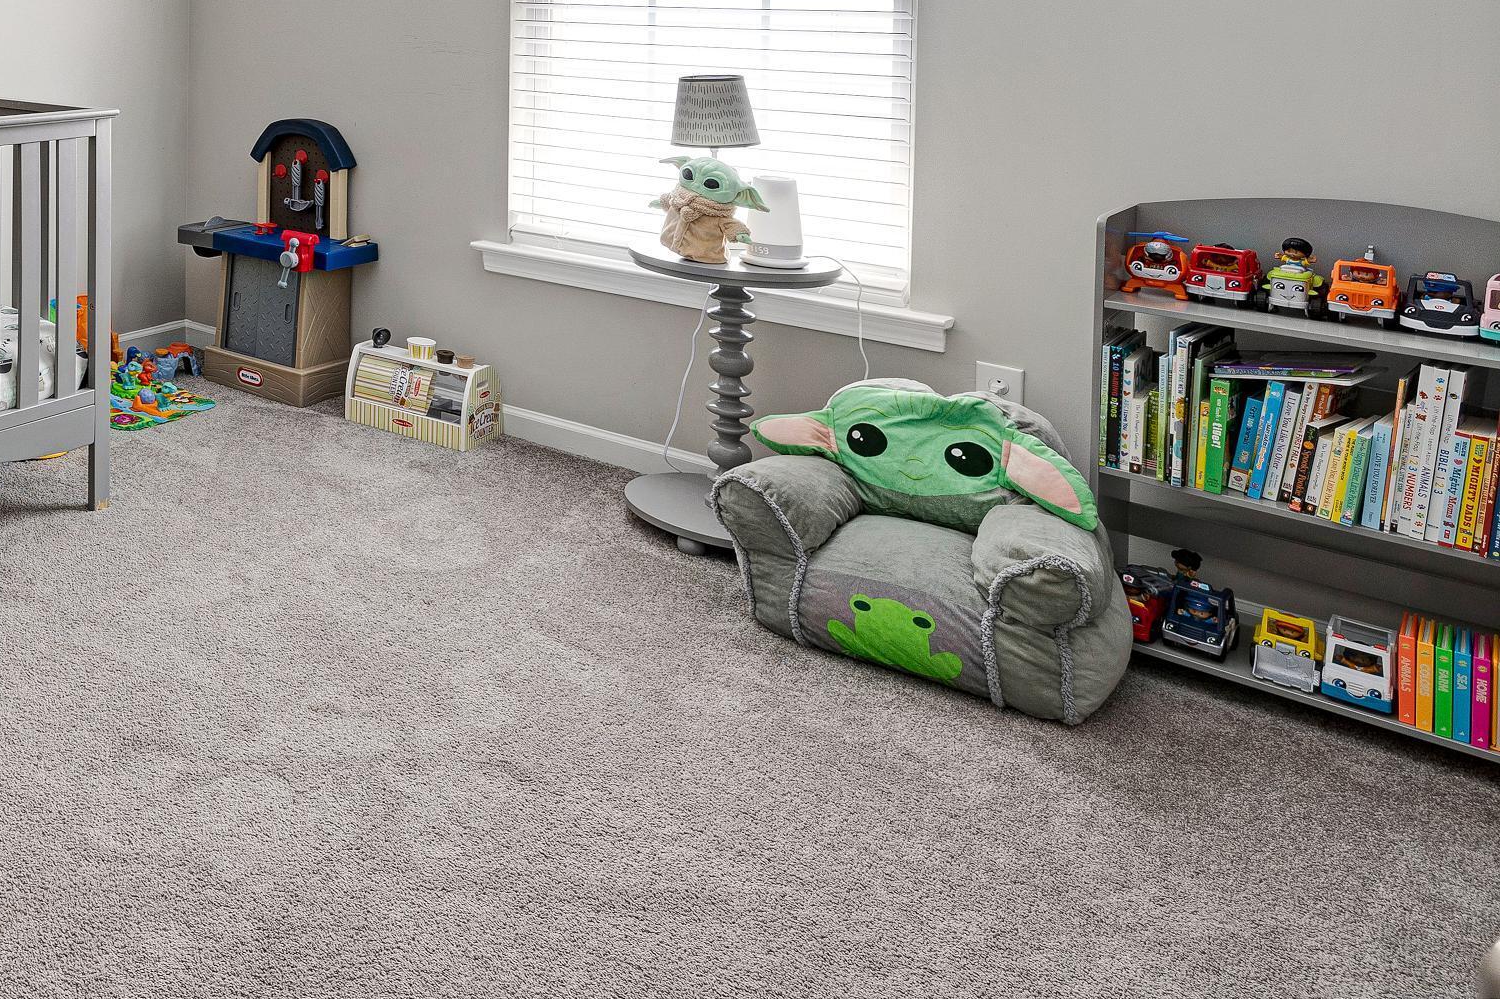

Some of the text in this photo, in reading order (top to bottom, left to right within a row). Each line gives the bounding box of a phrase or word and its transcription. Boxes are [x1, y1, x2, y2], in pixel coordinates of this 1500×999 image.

[1110, 361, 1120, 418] 10 DARING DINOS
[1284, 401, 1295, 416] Love
[1281, 417, 1292, 428] You
[1211, 422, 1223, 448] tiger!
[1278, 429, 1289, 443] Like
[1294, 433, 1303, 450] FIRST
[1276, 444, 1285, 452] No
[1290, 450, 1300, 462] FALL
[1273, 453, 1283, 469] Otter
[1437, 449, 1450, 472] BIBLE
[1295, 450, 1312, 496] Spooky Pookie
[1372, 467, 1380, 480] YOU
[1417, 466, 1431, 498] ANIMALS
[1370, 480, 1379, 504] FOREVER
[1402, 472, 1417, 511] NUMBERS
[1445, 467, 1462, 519] Mighty Moms
[1463, 465, 1481, 527] MIGHTY DADS
[1401, 656, 1411, 692] ANIMALS
[1437, 668, 1449, 693] FARM
[1456, 673, 1468, 690] SEA
[1475, 678, 1488, 704] HOME
